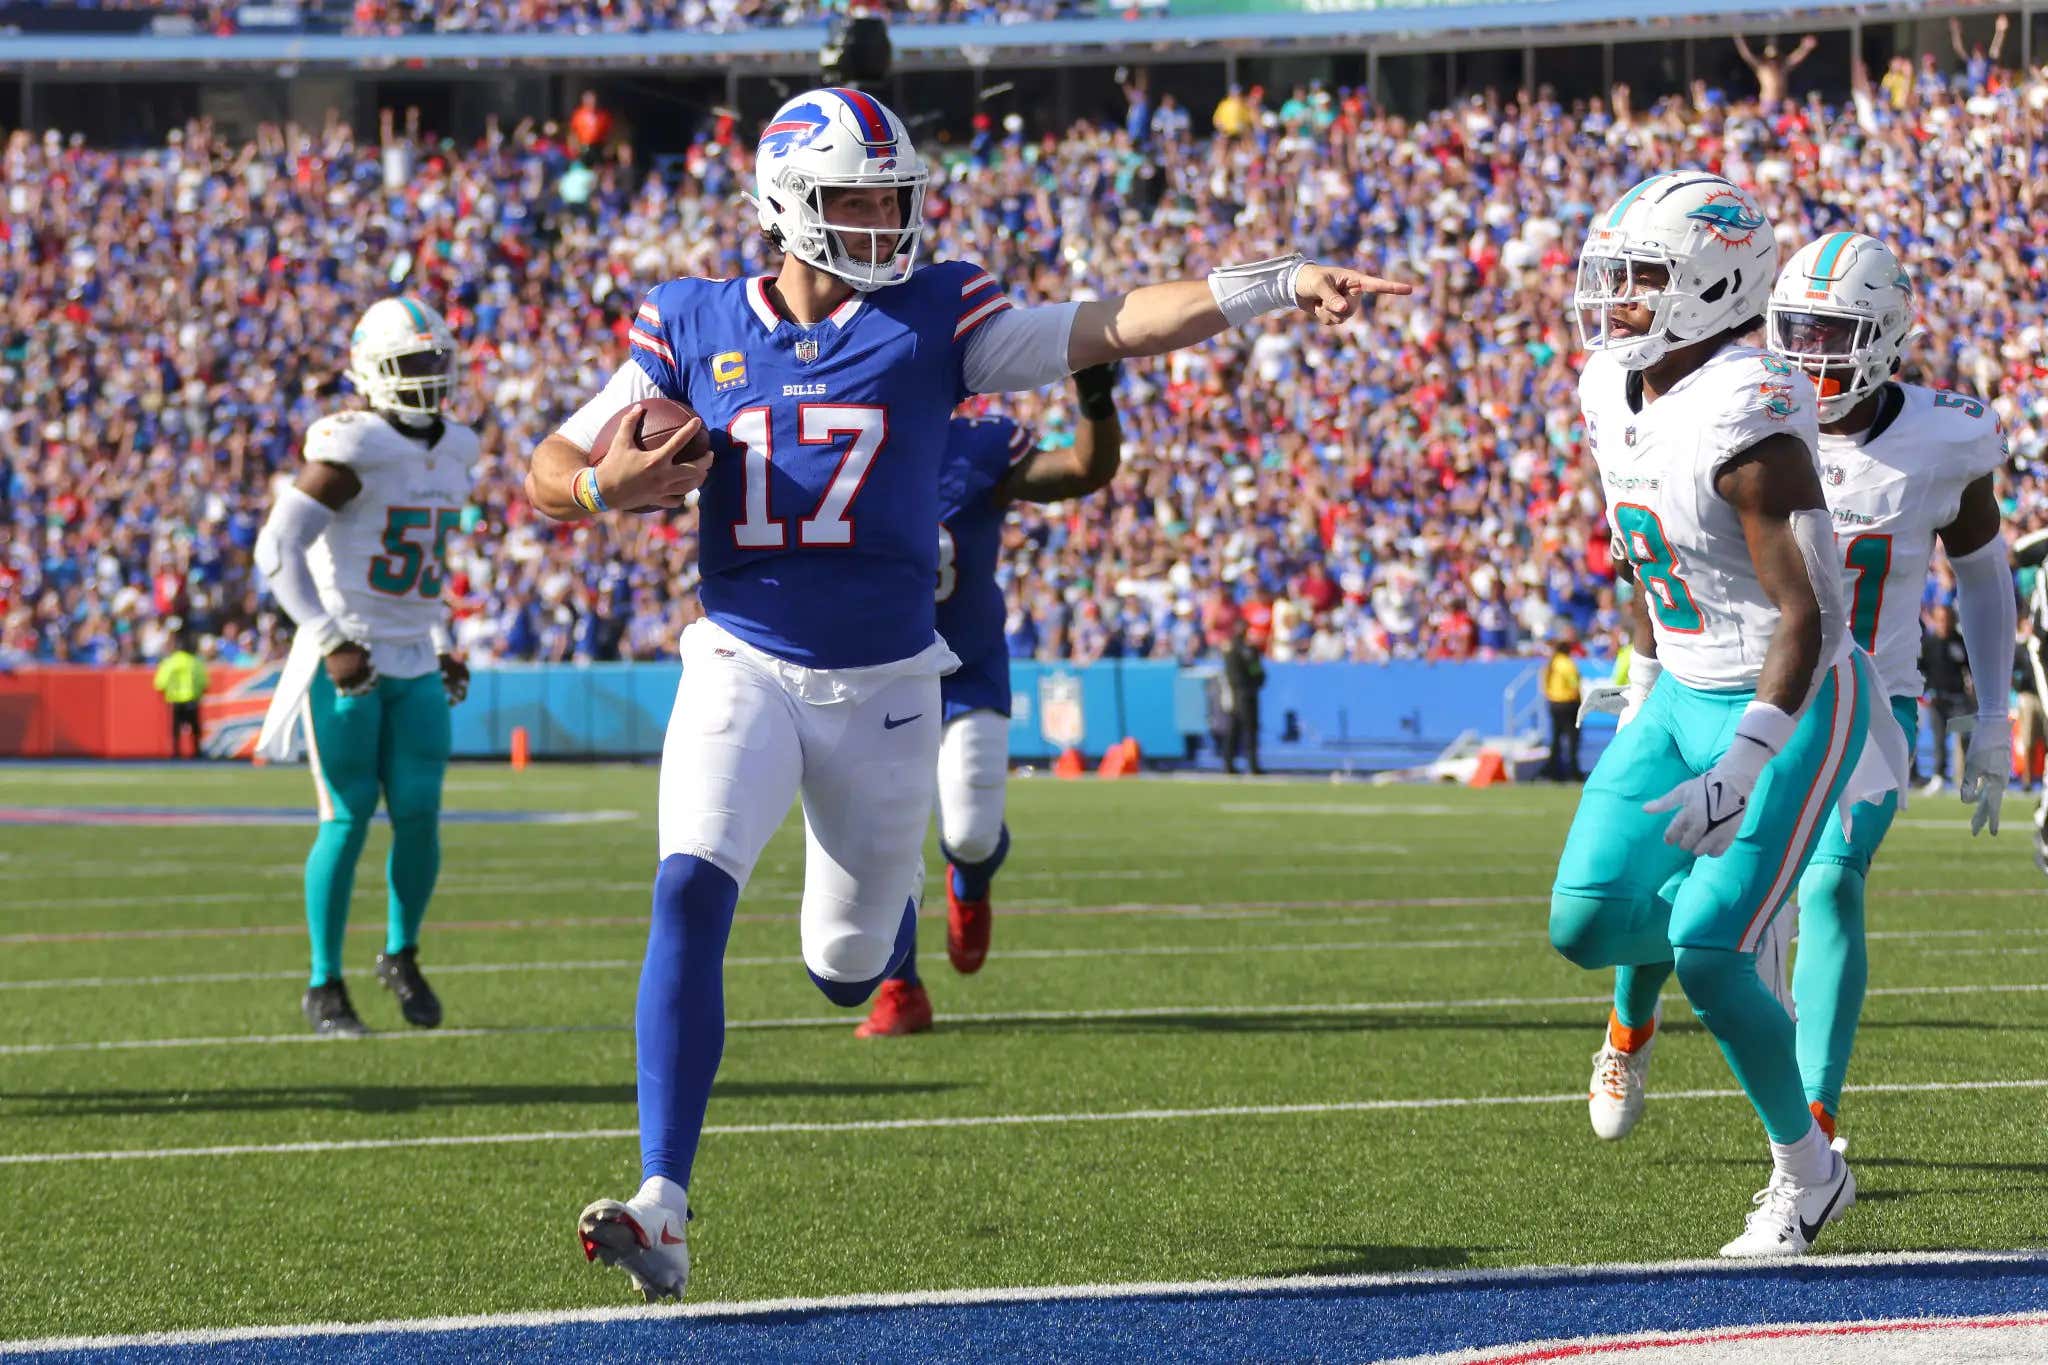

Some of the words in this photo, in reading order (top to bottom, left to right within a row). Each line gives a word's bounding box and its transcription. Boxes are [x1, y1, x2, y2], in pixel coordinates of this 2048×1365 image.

[712, 351, 745, 382] C
[782, 384, 827, 396] BILLS
[728, 403, 889, 550] 17
[1831, 507, 1874, 526] hins
[369, 506, 461, 598] 55
[1614, 502, 1706, 635] 8
[1833, 531, 1893, 656] 1
